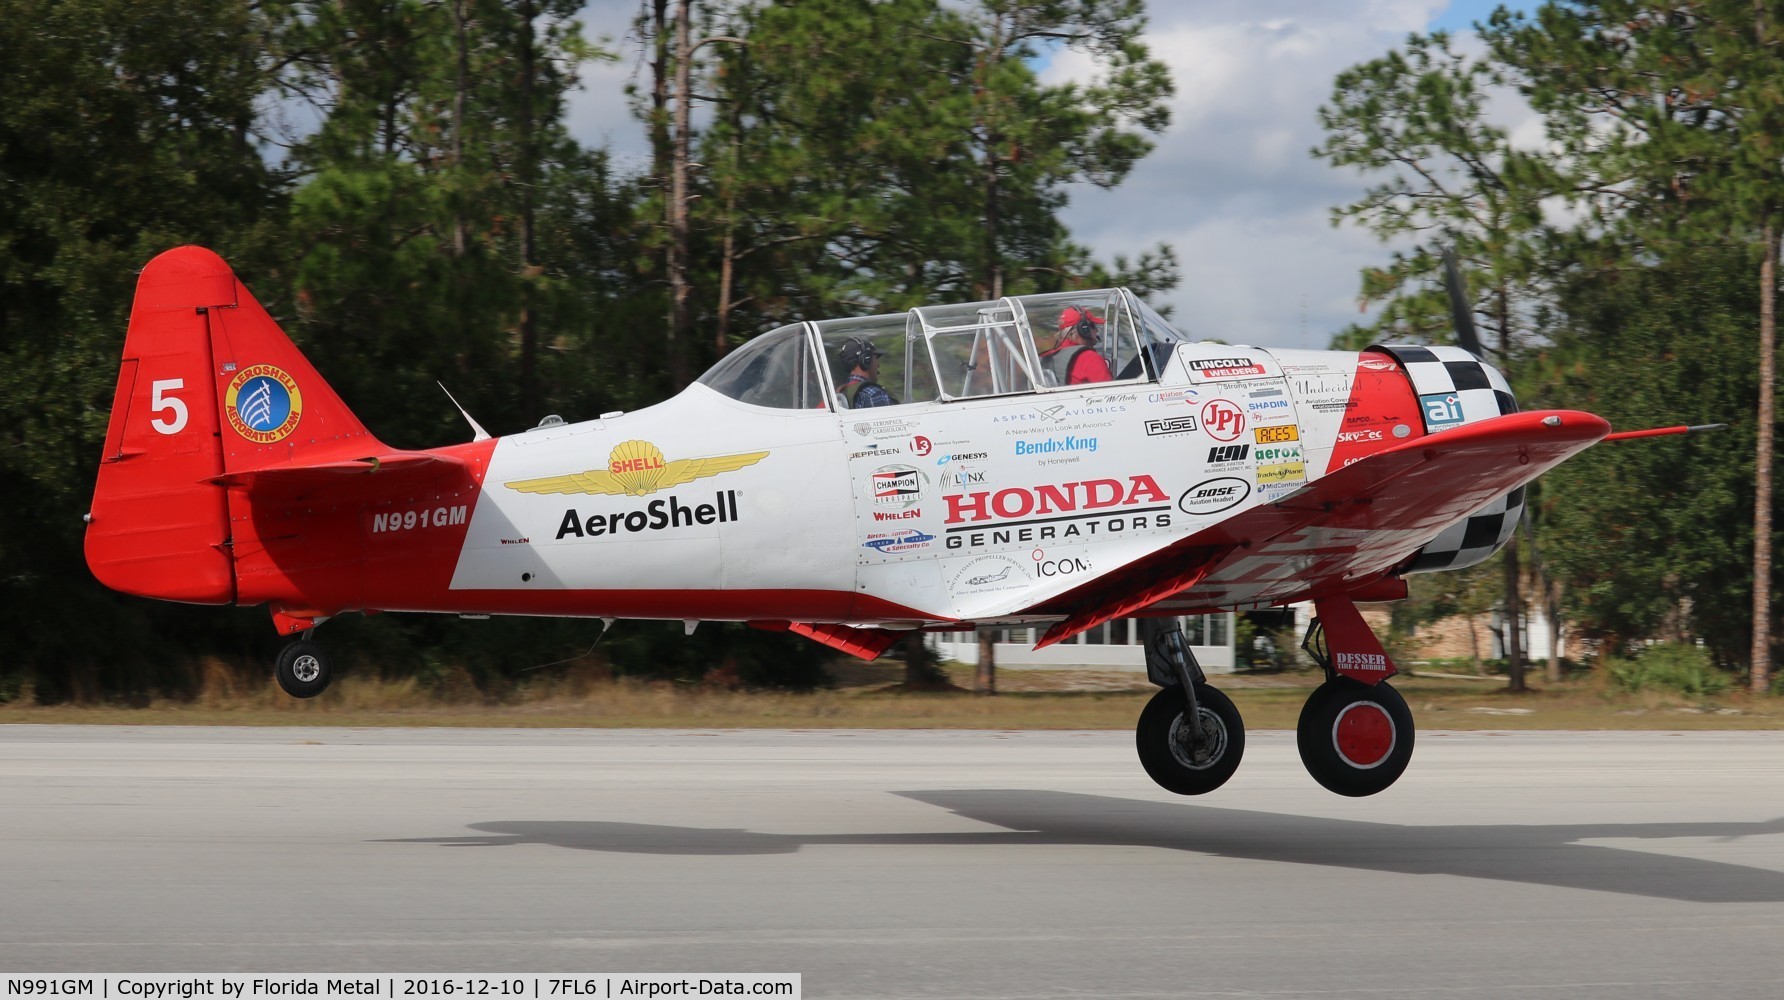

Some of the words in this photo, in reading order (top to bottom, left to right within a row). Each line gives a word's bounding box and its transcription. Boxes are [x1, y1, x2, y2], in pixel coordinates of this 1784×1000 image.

[1193, 359, 1250, 370] LINCOLN
[1209, 368, 1259, 377] WELDERS
[232, 366, 297, 394] AEROSHELL
[151, 378, 188, 435] 5
[1248, 400, 1288, 410] SHADIN
[993, 414, 1036, 422] ASPEN
[1065, 406, 1126, 416] AVIONICS
[1206, 404, 1242, 436] JPI
[227, 405, 276, 442] AEROBATIC
[277, 411, 300, 438] TEAM
[1029, 427, 1045, 435] Way
[1055, 424, 1072, 432] Look
[1082, 420, 1112, 429] Avionics
[1150, 420, 1192, 432] FUSE
[1260, 427, 1290, 442] ACES
[1016, 436, 1097, 456] BendixKing
[850, 448, 900, 459] JEPPESEN
[952, 452, 988, 460] GENESYS
[1255, 448, 1300, 460] aerox
[612, 457, 663, 474] SHELL
[1048, 456, 1080, 466] Honeywell
[876, 478, 915, 490] CHAMPION
[876, 492, 922, 504] AEROSPACE
[1196, 486, 1237, 498] BOSE
[942, 474, 1170, 524] HONDA
[373, 506, 467, 532] N991GM
[556, 490, 738, 540] AeroShell
[873, 508, 920, 521] WHELEN
[946, 514, 1172, 550] GENERATORS
[500, 537, 530, 545] WHELEN
[1336, 652, 1386, 665] DESSER
